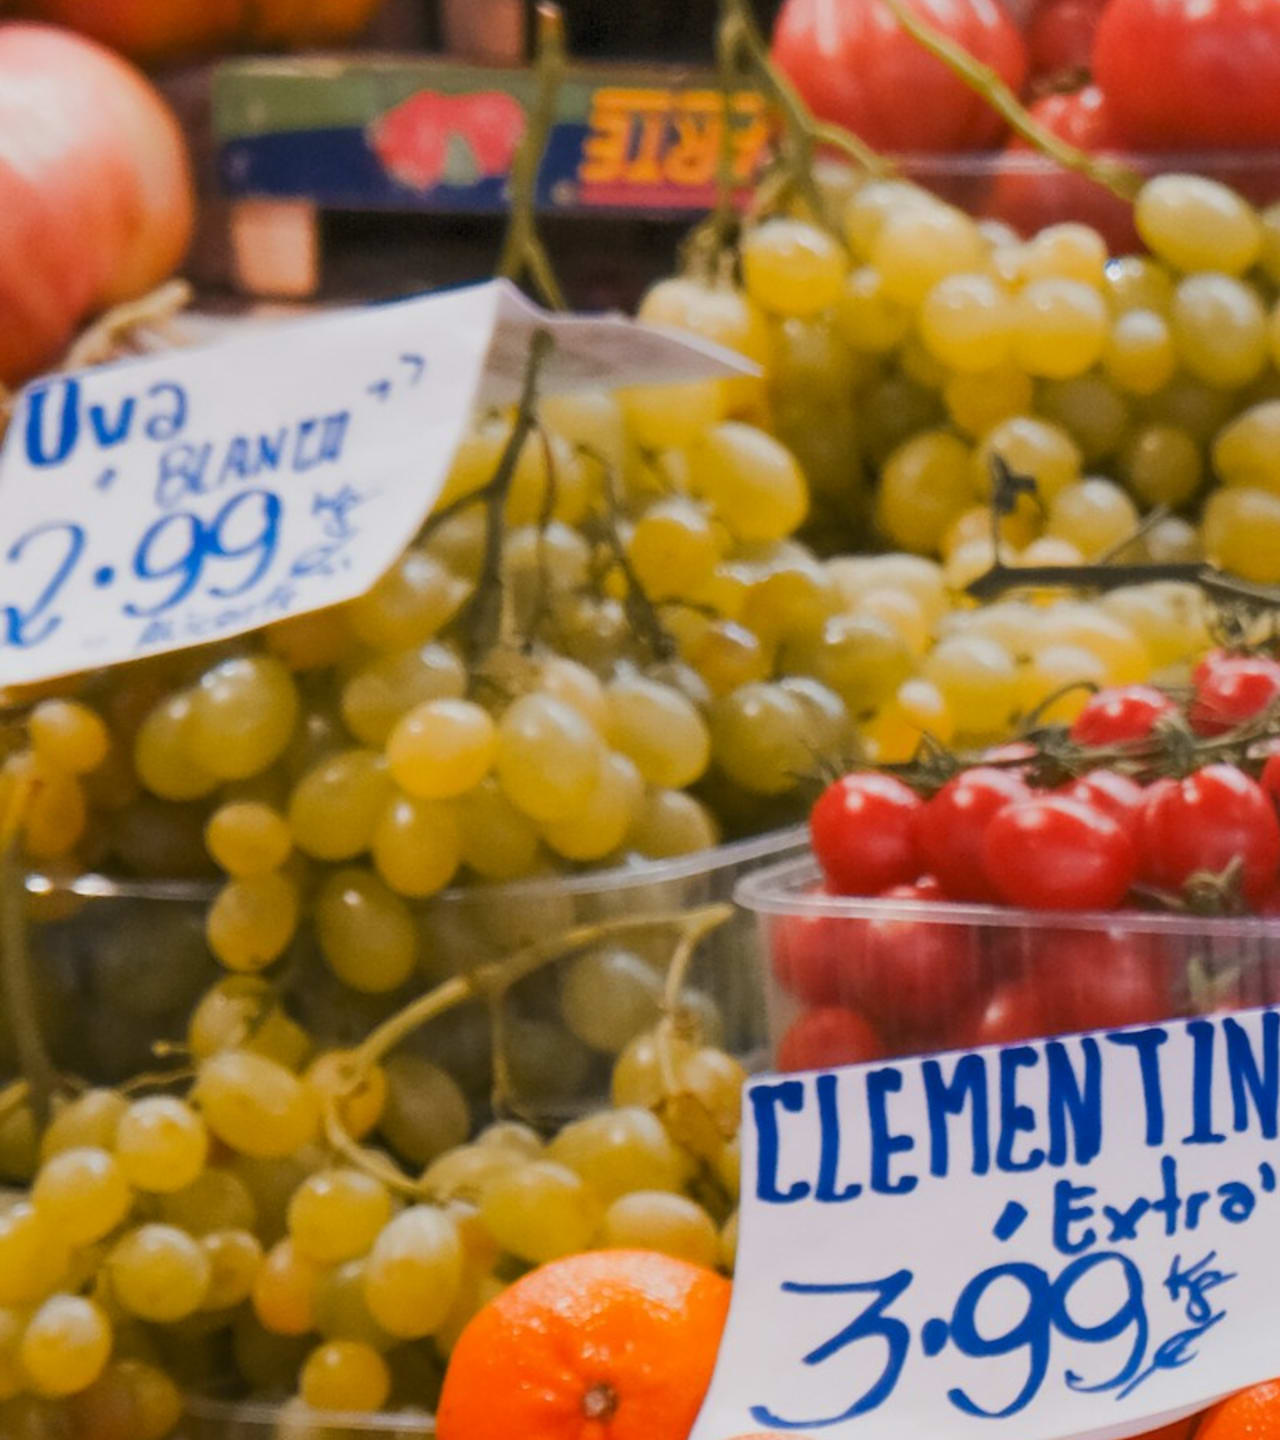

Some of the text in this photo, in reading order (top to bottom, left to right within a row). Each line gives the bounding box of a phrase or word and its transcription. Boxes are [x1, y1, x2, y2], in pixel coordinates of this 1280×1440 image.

[26, 377, 188, 468] Uva
[3, 490, 281, 648] 2.99
[750, 1251, 1150, 1429] 3.99
